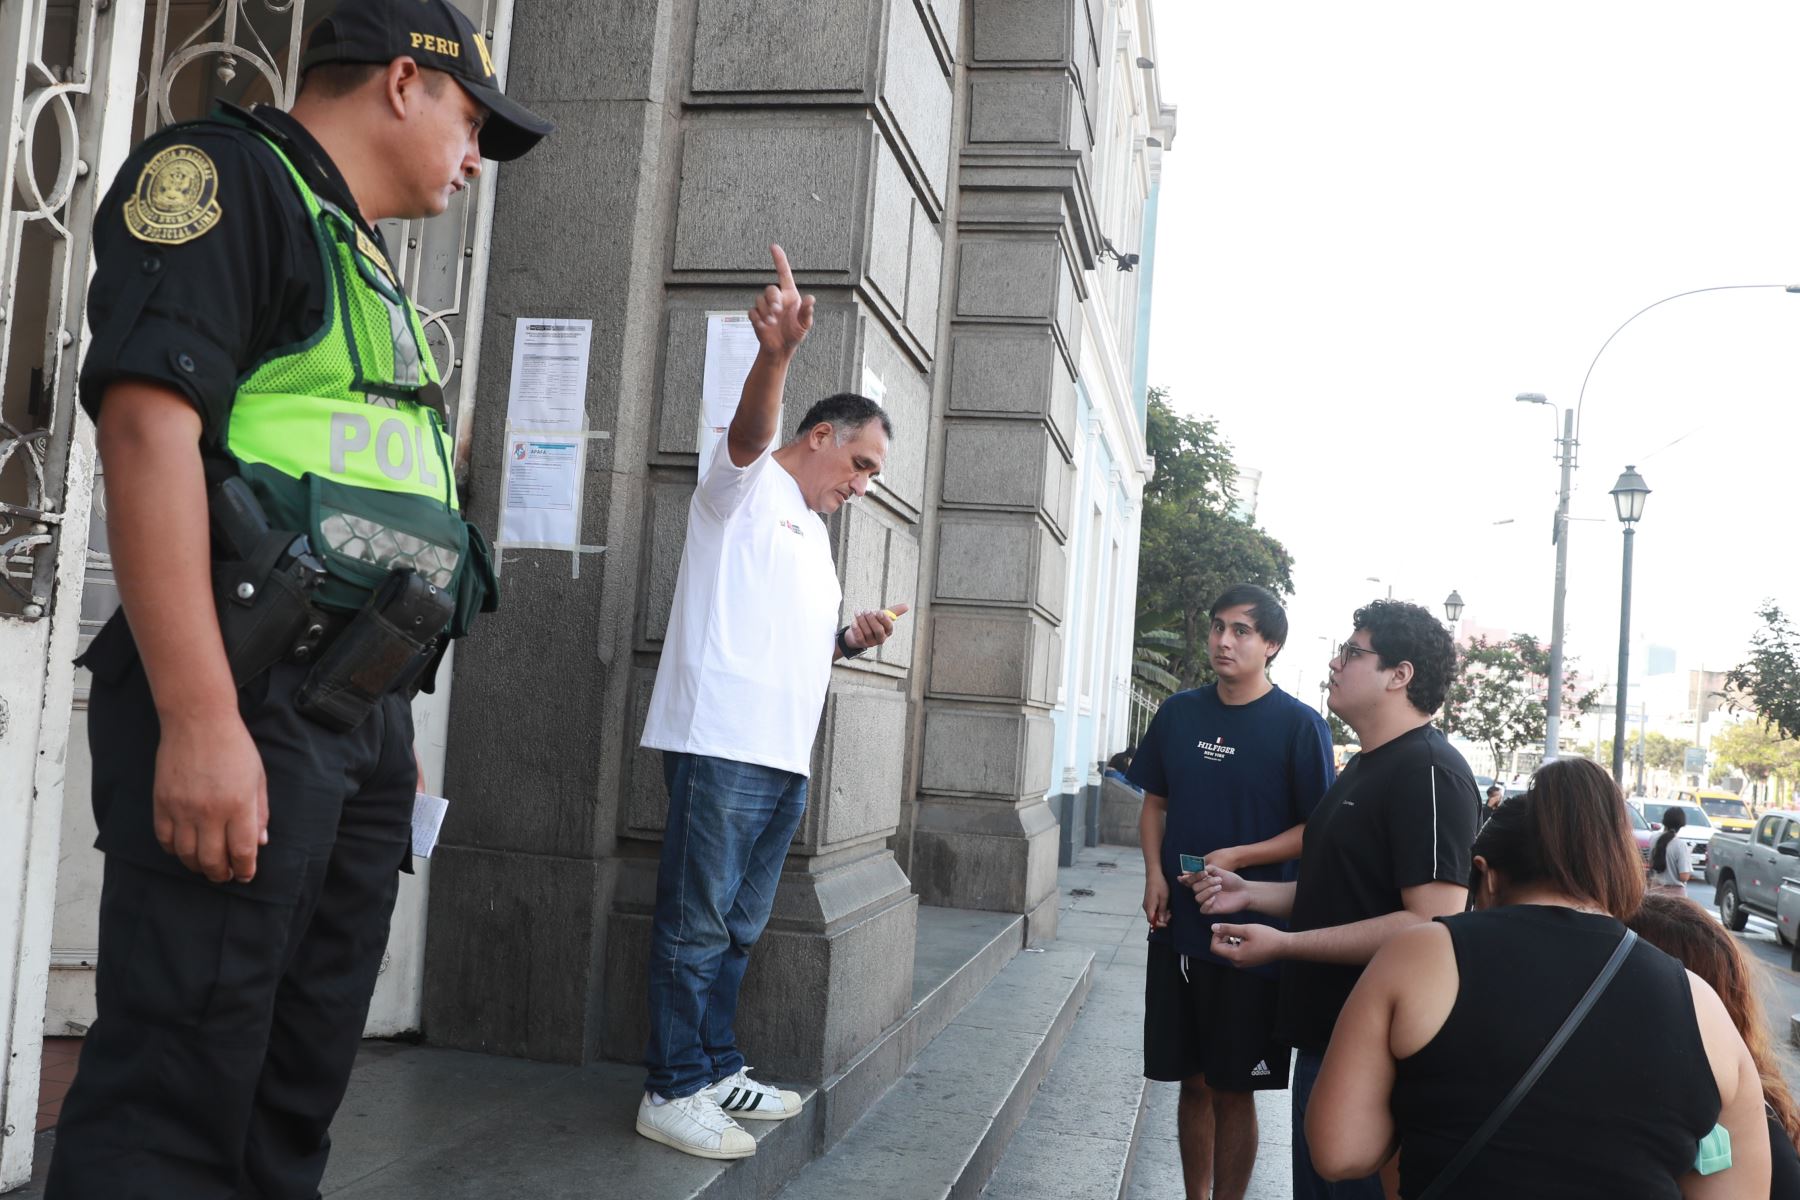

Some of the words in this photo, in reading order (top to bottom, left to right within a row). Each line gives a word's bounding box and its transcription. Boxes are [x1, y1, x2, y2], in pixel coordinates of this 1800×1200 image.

[409, 32, 460, 58] PERU
[194, 210, 216, 230] LIMA
[330, 411, 437, 488] POL
[1197, 740, 1236, 755] HILFIGER
